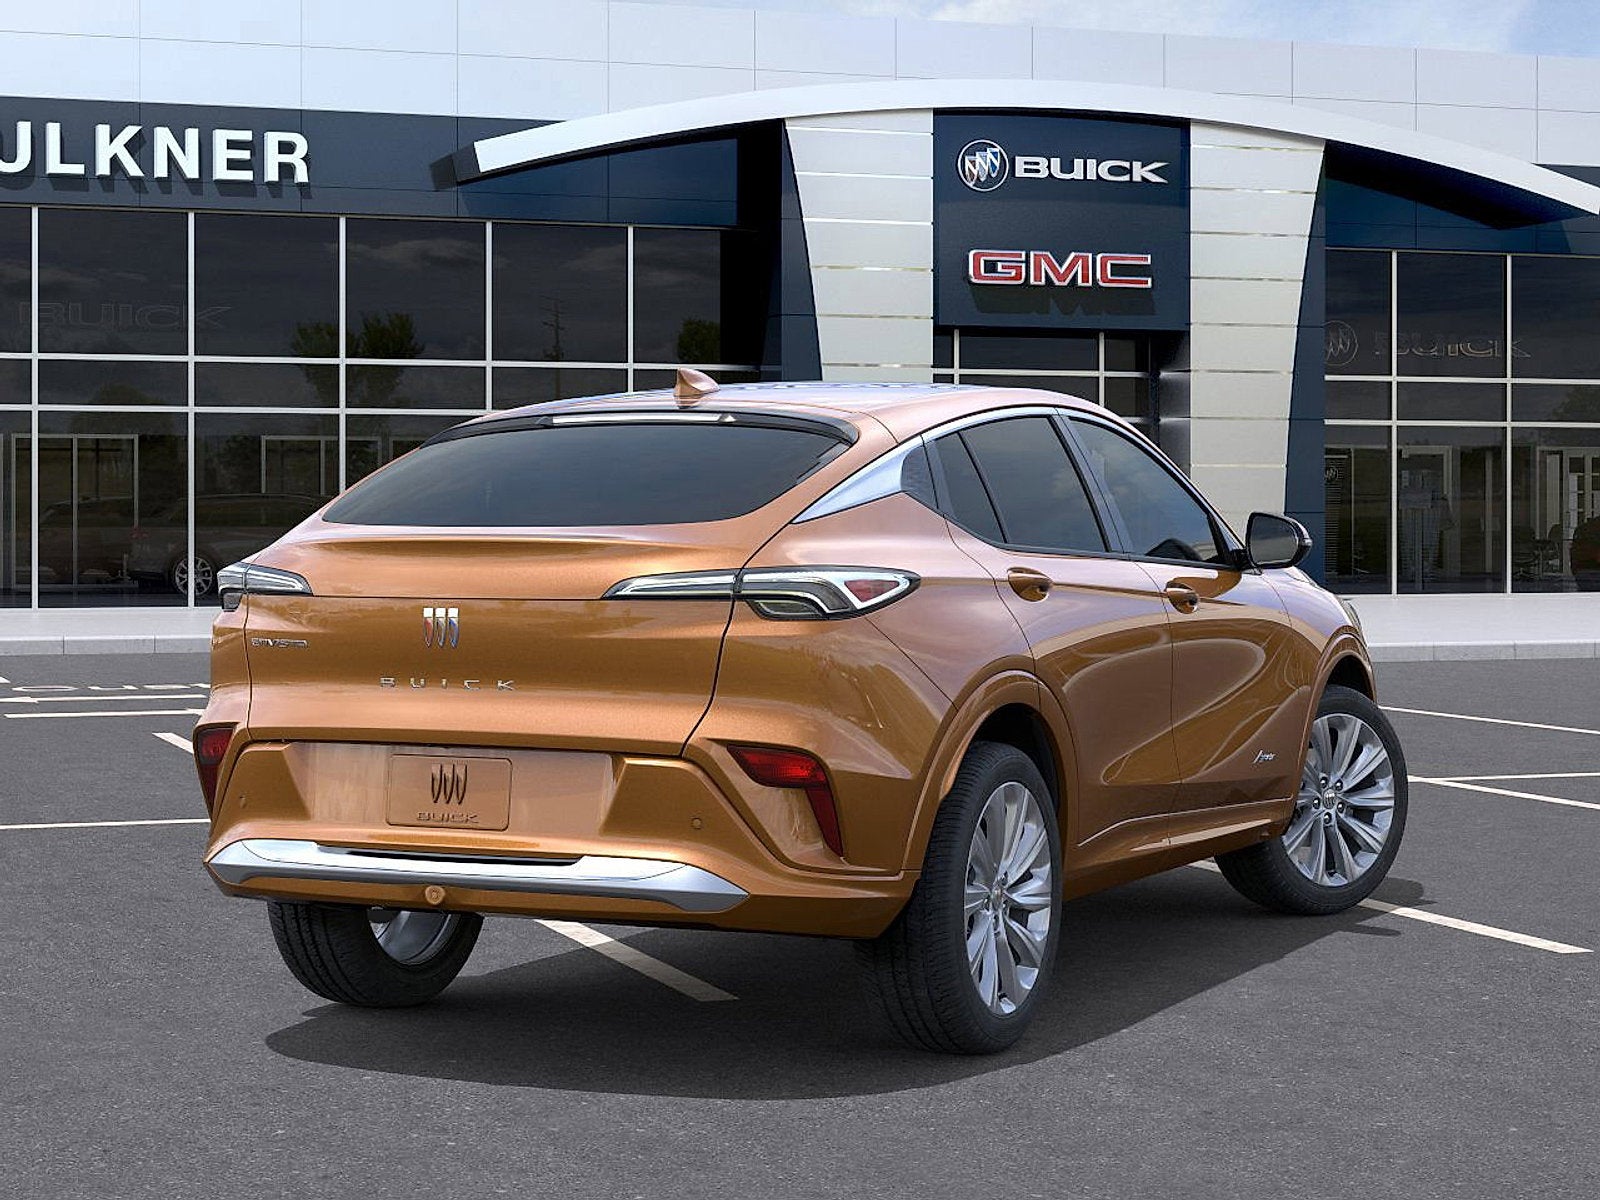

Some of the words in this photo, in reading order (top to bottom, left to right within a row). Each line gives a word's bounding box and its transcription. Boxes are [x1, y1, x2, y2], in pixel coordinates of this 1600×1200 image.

[1014, 156, 1169, 183] BUICK
[969, 249, 1152, 288] GMC
[380, 677, 514, 691] BUICK
[416, 812, 479, 824] BUICK
